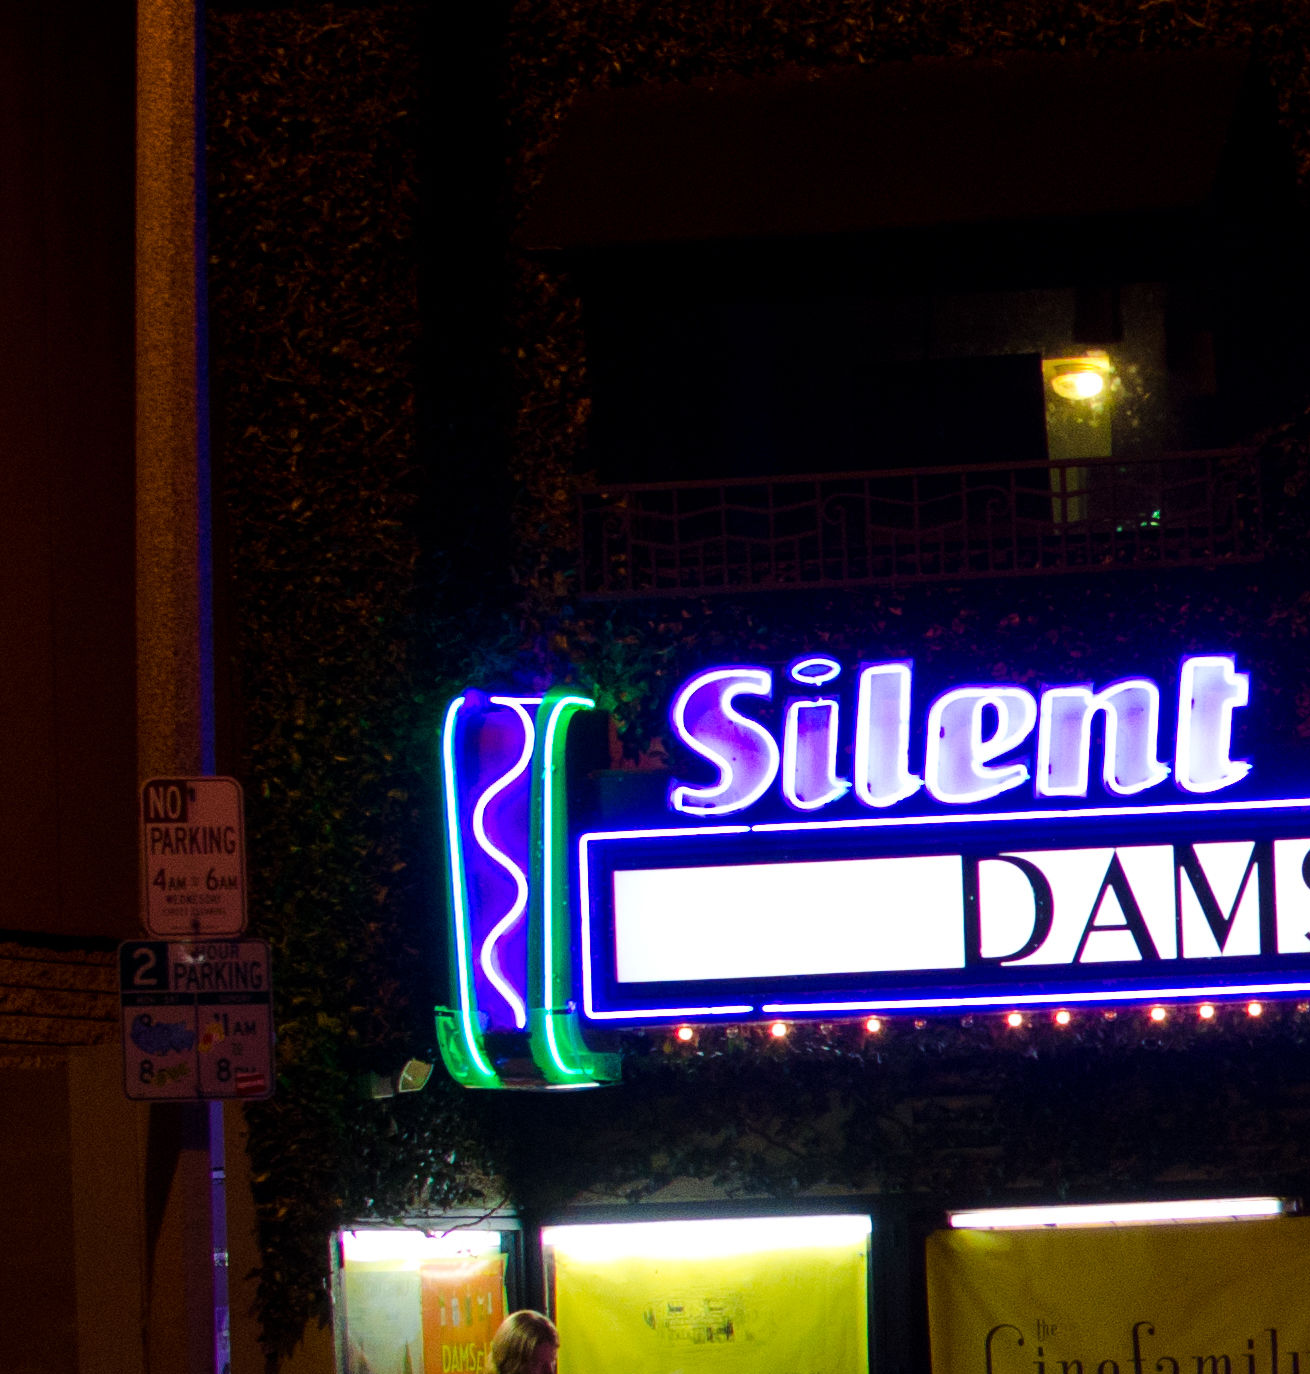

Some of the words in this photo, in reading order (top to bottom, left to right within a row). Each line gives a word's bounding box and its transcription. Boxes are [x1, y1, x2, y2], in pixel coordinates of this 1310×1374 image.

[670, 654, 1253, 817] Silent
[149, 784, 183, 820] NO
[150, 826, 237, 855] PARKING
[132, 947, 159, 987] 2
[173, 961, 262, 991] PARKING
